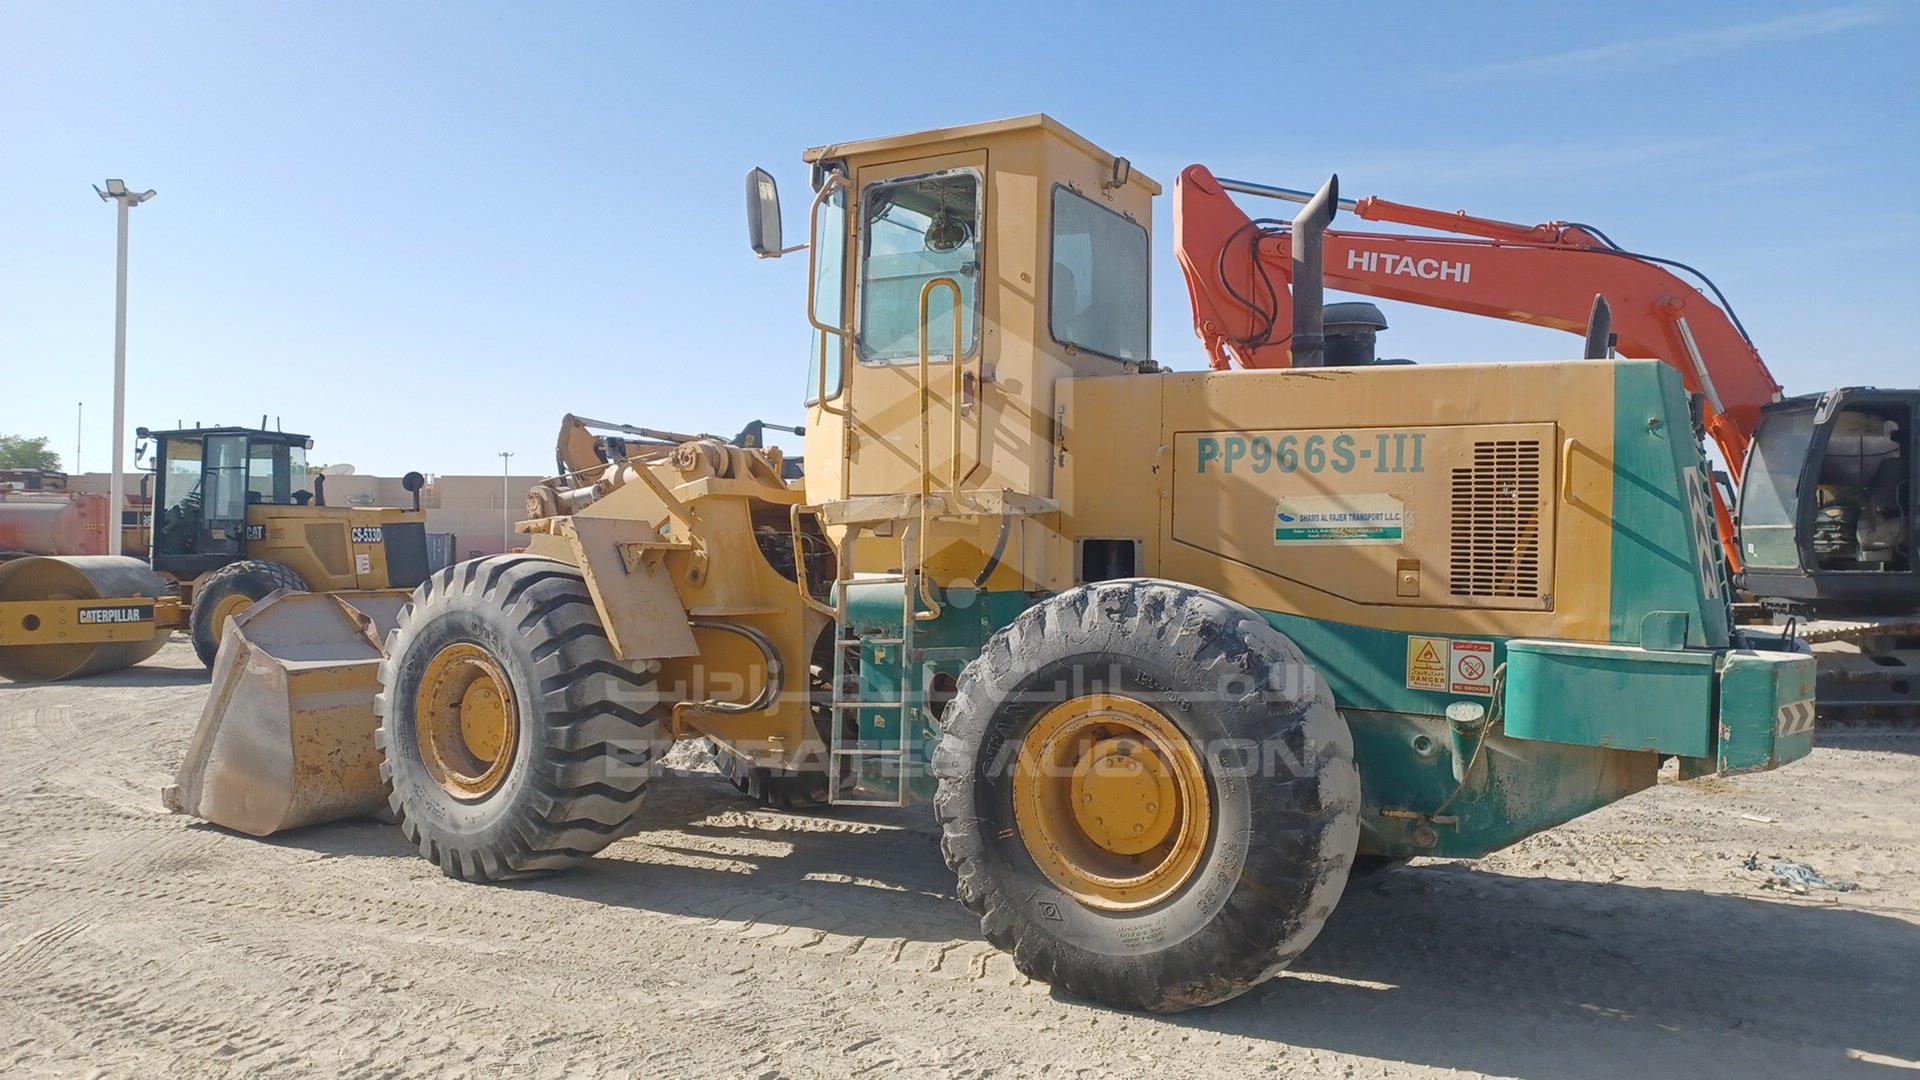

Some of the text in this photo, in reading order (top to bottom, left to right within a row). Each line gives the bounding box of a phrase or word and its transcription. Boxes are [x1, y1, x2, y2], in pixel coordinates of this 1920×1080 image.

[1347, 249, 1471, 283] HITACHI
[1197, 434, 1426, 474] PP966S-III
[1321, 514, 1328, 522] AL
[1329, 514, 1347, 522] FAJER
[1348, 513, 1383, 521] TRANSPORT
[246, 525, 263, 539] CAT
[352, 527, 382, 542] CS-533D
[80, 608, 140, 623] CATERPILLAR
[1464, 684, 1489, 693] SMOKING
